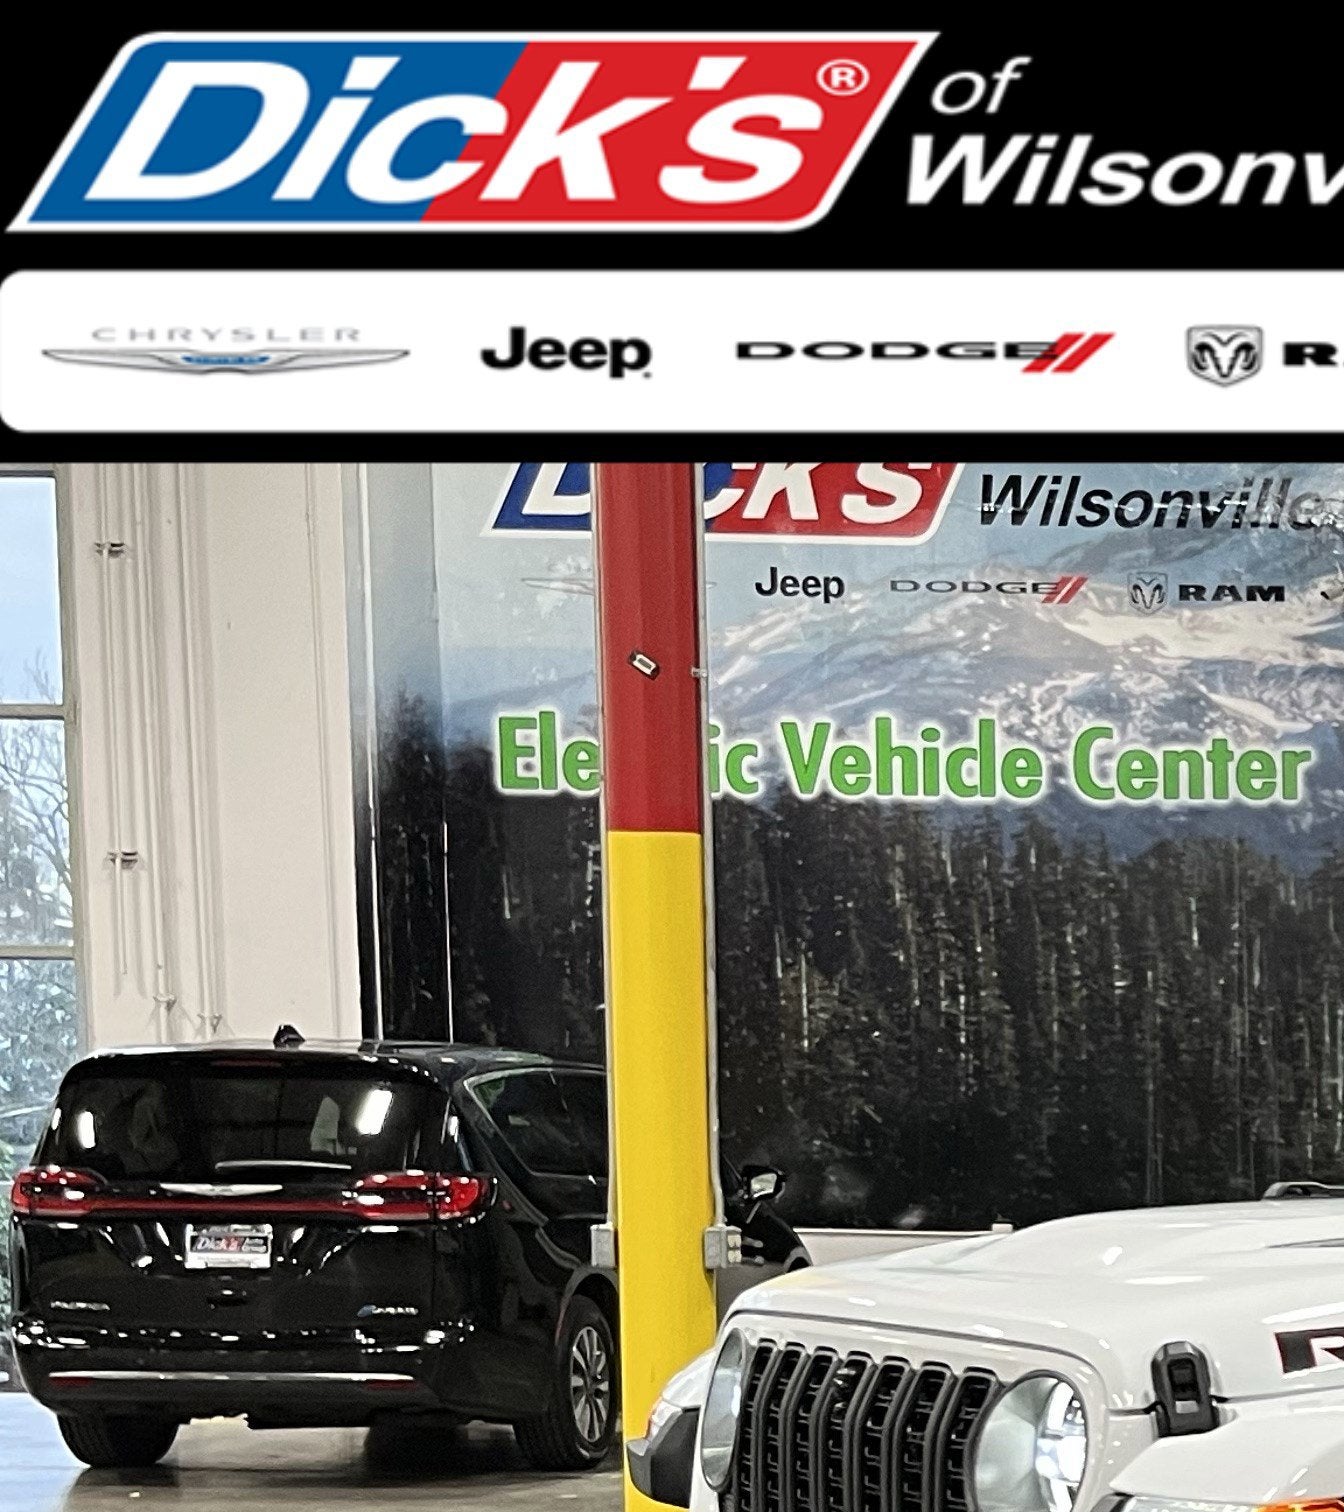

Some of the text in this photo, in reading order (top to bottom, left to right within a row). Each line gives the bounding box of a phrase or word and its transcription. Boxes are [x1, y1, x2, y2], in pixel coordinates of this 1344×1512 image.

[754, 566, 846, 603] Jeep
[889, 579, 1060, 595] DODGE
[1177, 584, 1286, 602] RAM
[779, 715, 1044, 799] Vehicle
[1072, 725, 1312, 800] Center
